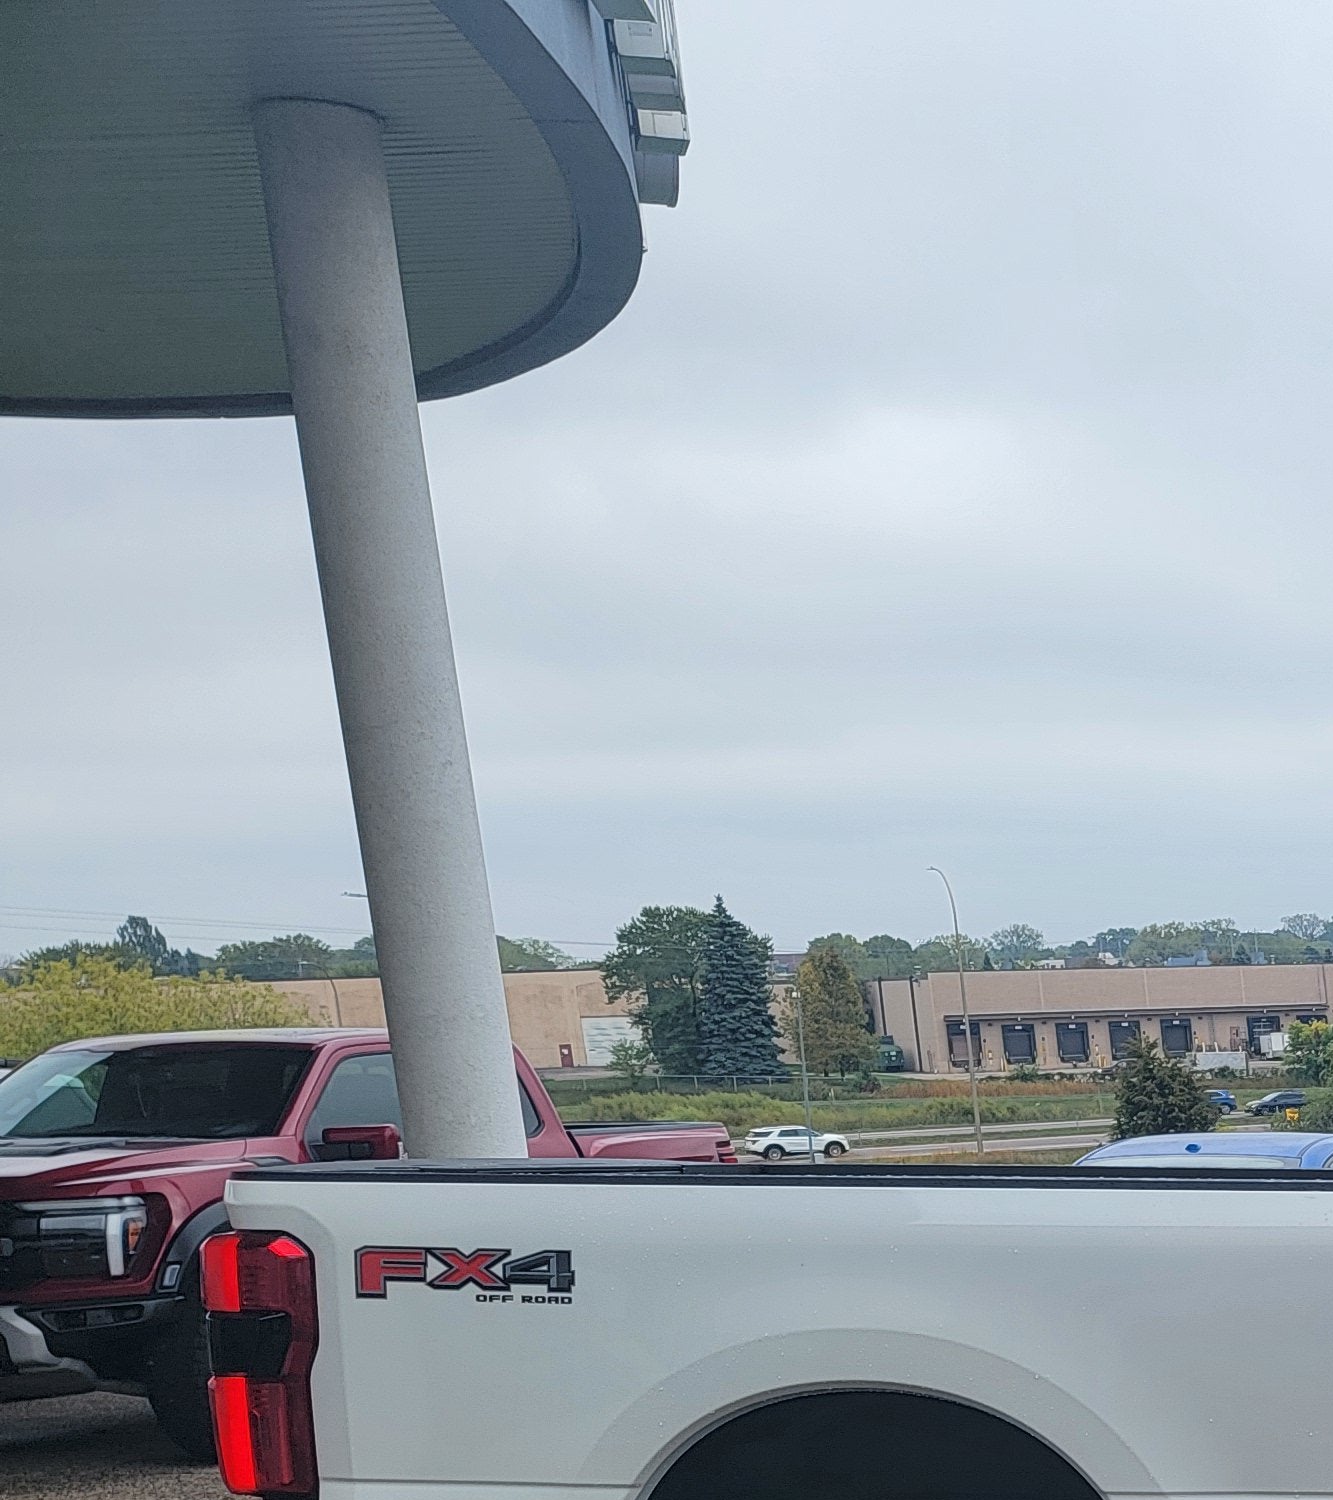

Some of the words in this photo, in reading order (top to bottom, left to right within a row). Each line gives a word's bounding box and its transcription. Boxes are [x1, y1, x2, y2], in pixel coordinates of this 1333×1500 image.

[354, 1245, 575, 1299] FX4
[475, 1294, 514, 1303] OFF
[521, 1295, 573, 1304] ROAD
